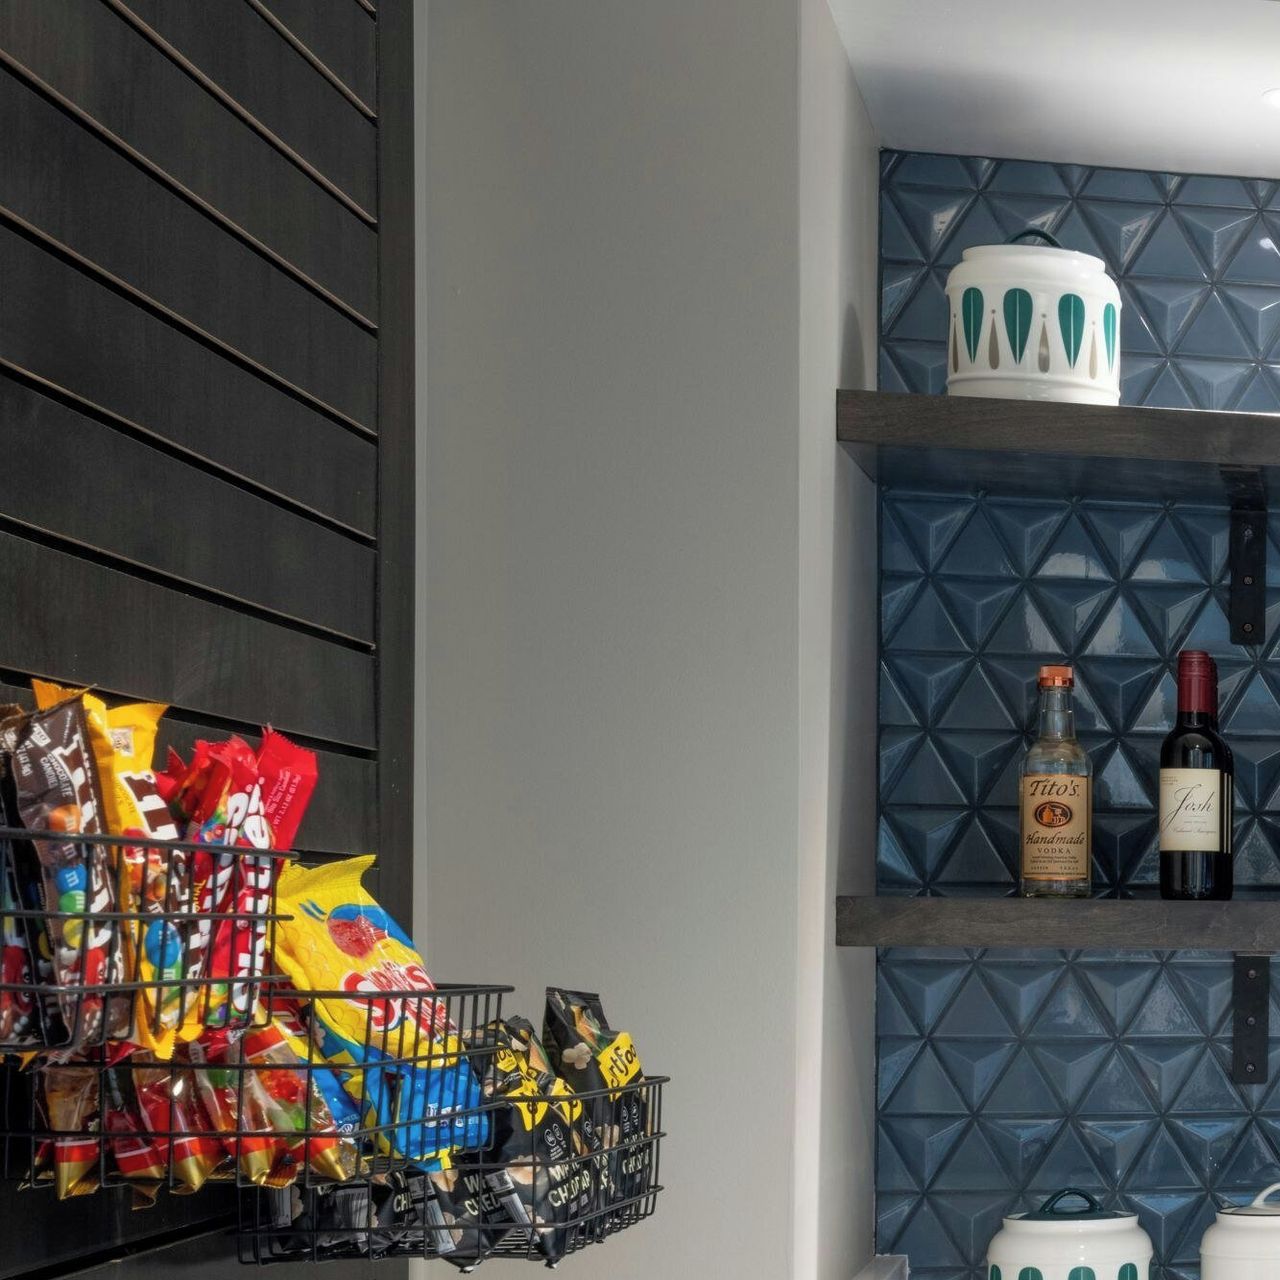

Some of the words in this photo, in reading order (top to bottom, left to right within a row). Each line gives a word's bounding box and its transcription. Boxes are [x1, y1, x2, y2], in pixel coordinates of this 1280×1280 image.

[1029, 778, 1079, 797] Tito's
[1160, 784, 1215, 833] Josh
[1025, 831, 1085, 846] Handmade
